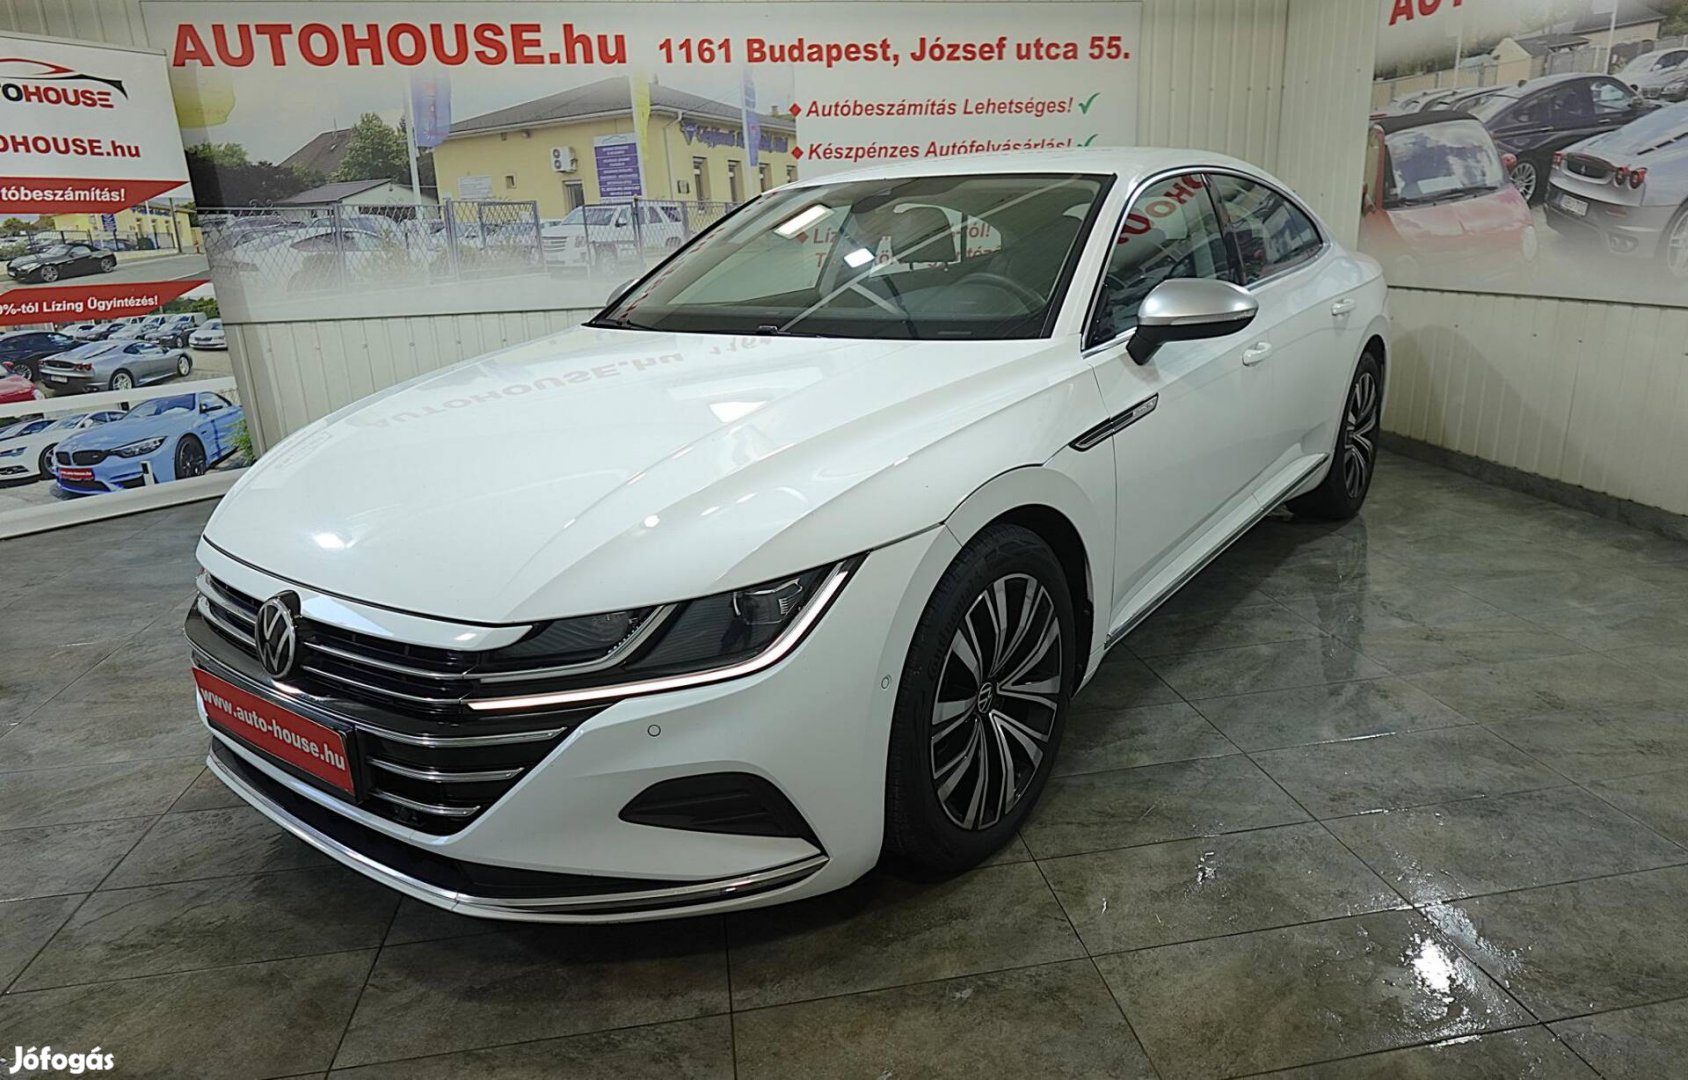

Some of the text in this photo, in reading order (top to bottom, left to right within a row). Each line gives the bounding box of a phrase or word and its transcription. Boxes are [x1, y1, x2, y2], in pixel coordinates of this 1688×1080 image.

[172, 23, 628, 67] AUTOHOUSE.hu
[658, 36, 1130, 68] 1161 Budapest, József utca 55.
[0, 83, 115, 108] OHOUSE
[806, 97, 1073, 118] Autóbeszámítás Lehetséges!
[808, 142, 920, 163] Készpénzes
[43, 301, 84, 313] Lízing
[87, 296, 158, 311] Ügyintézés!
[200, 687, 347, 771] www.auto-house.hu
